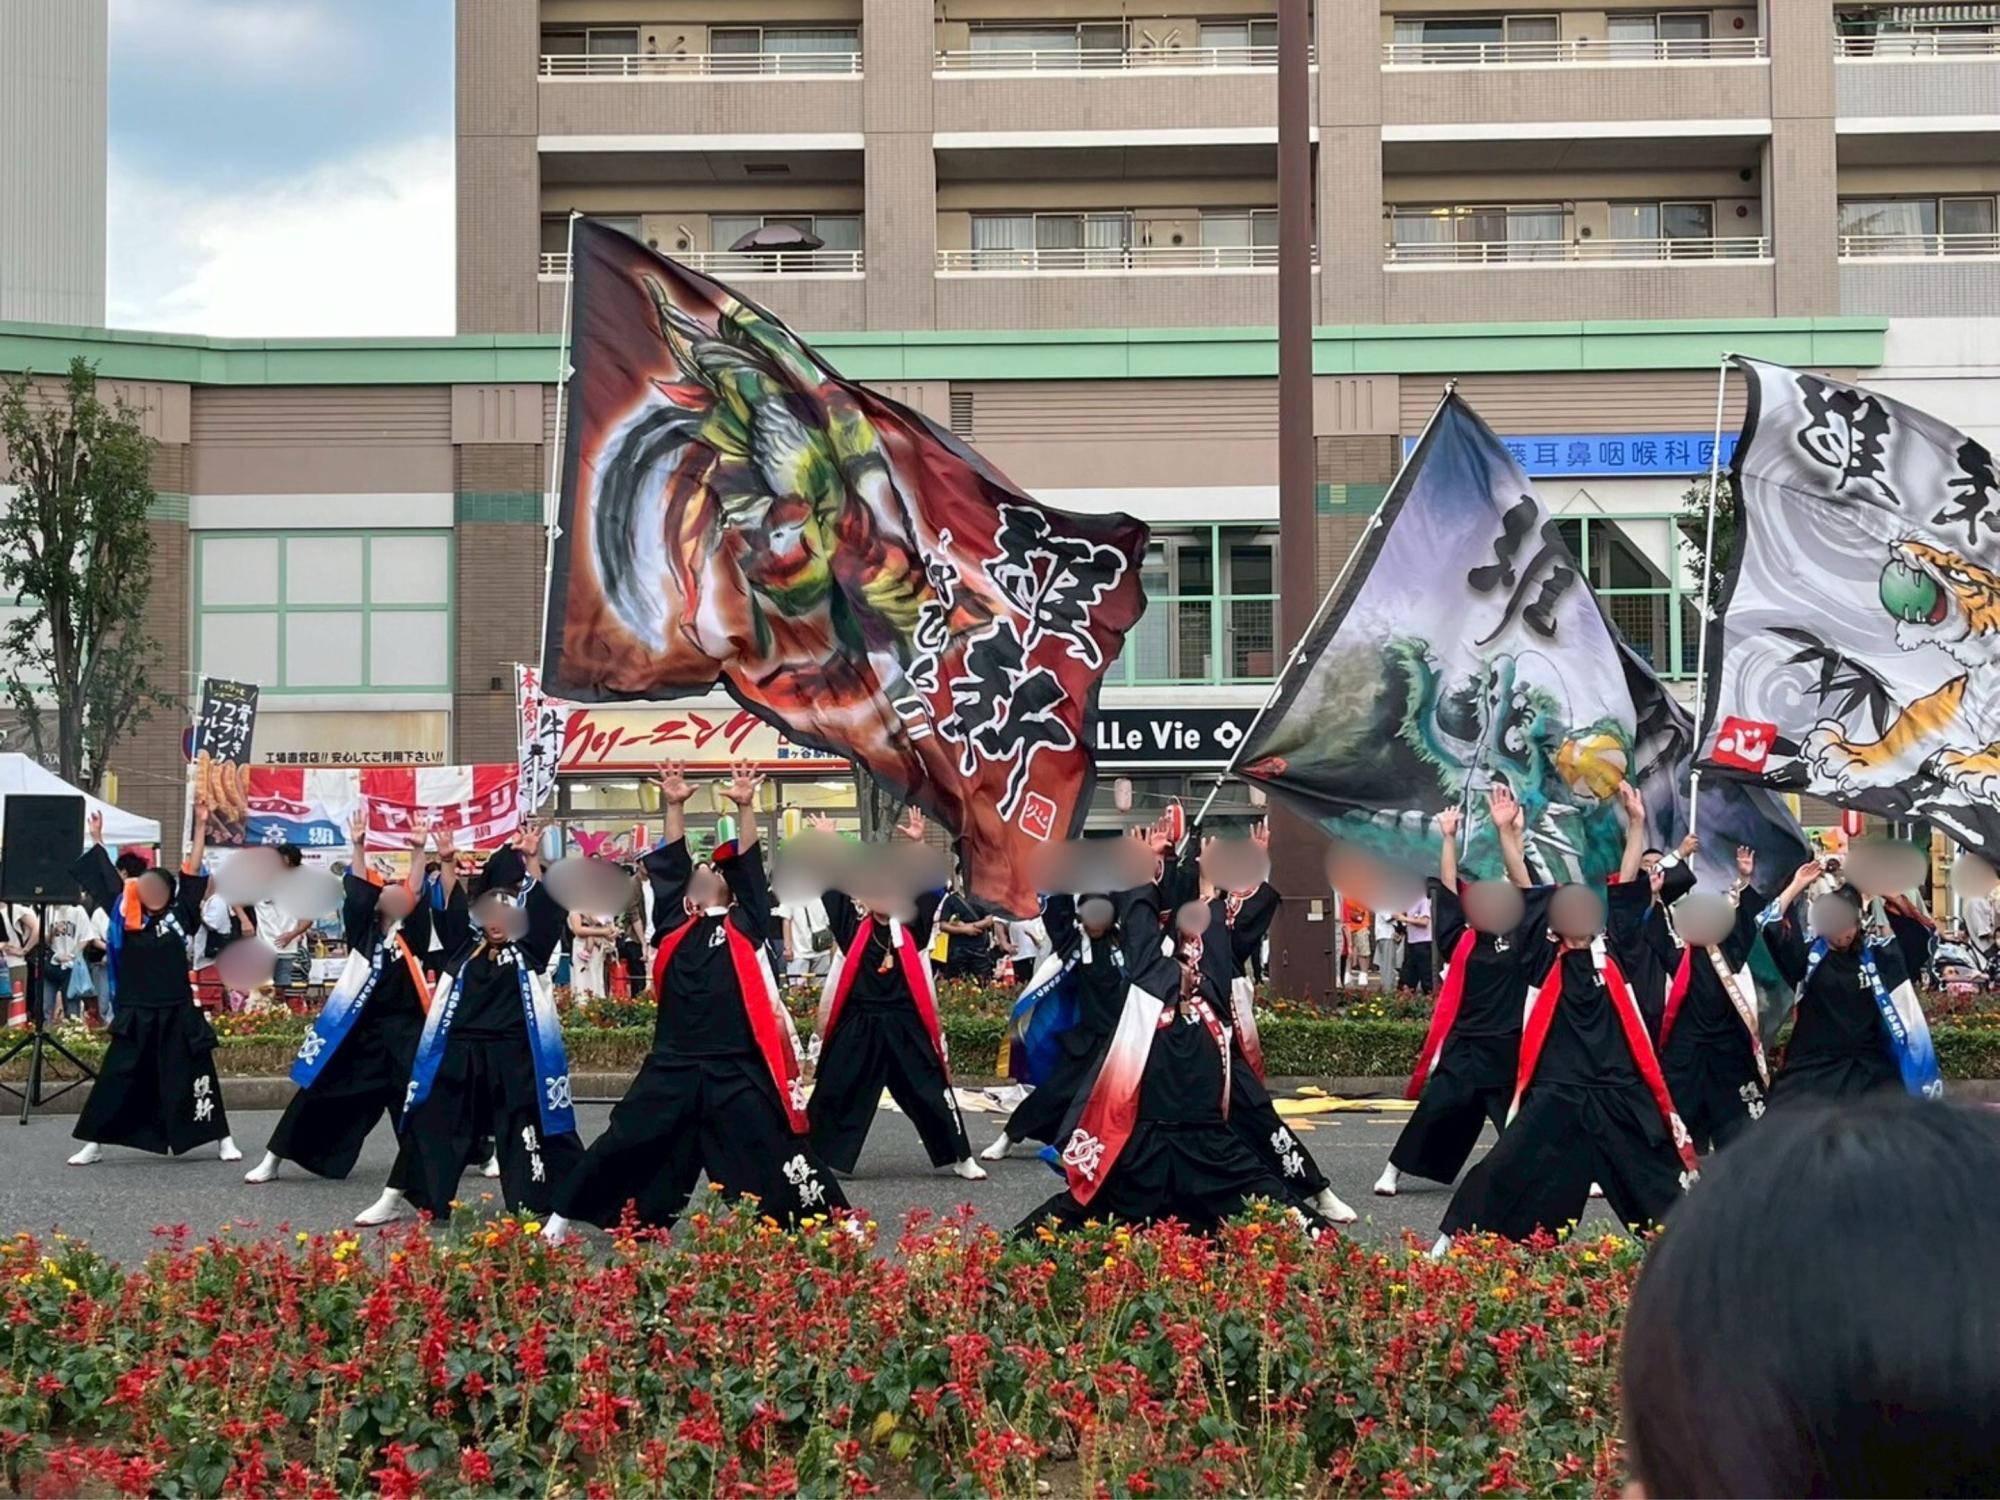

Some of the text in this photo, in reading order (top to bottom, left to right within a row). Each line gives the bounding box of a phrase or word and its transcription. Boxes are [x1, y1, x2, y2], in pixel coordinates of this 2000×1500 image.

[230, 703, 253, 757] 骨付き
[1150, 721, 1200, 750] Vie
